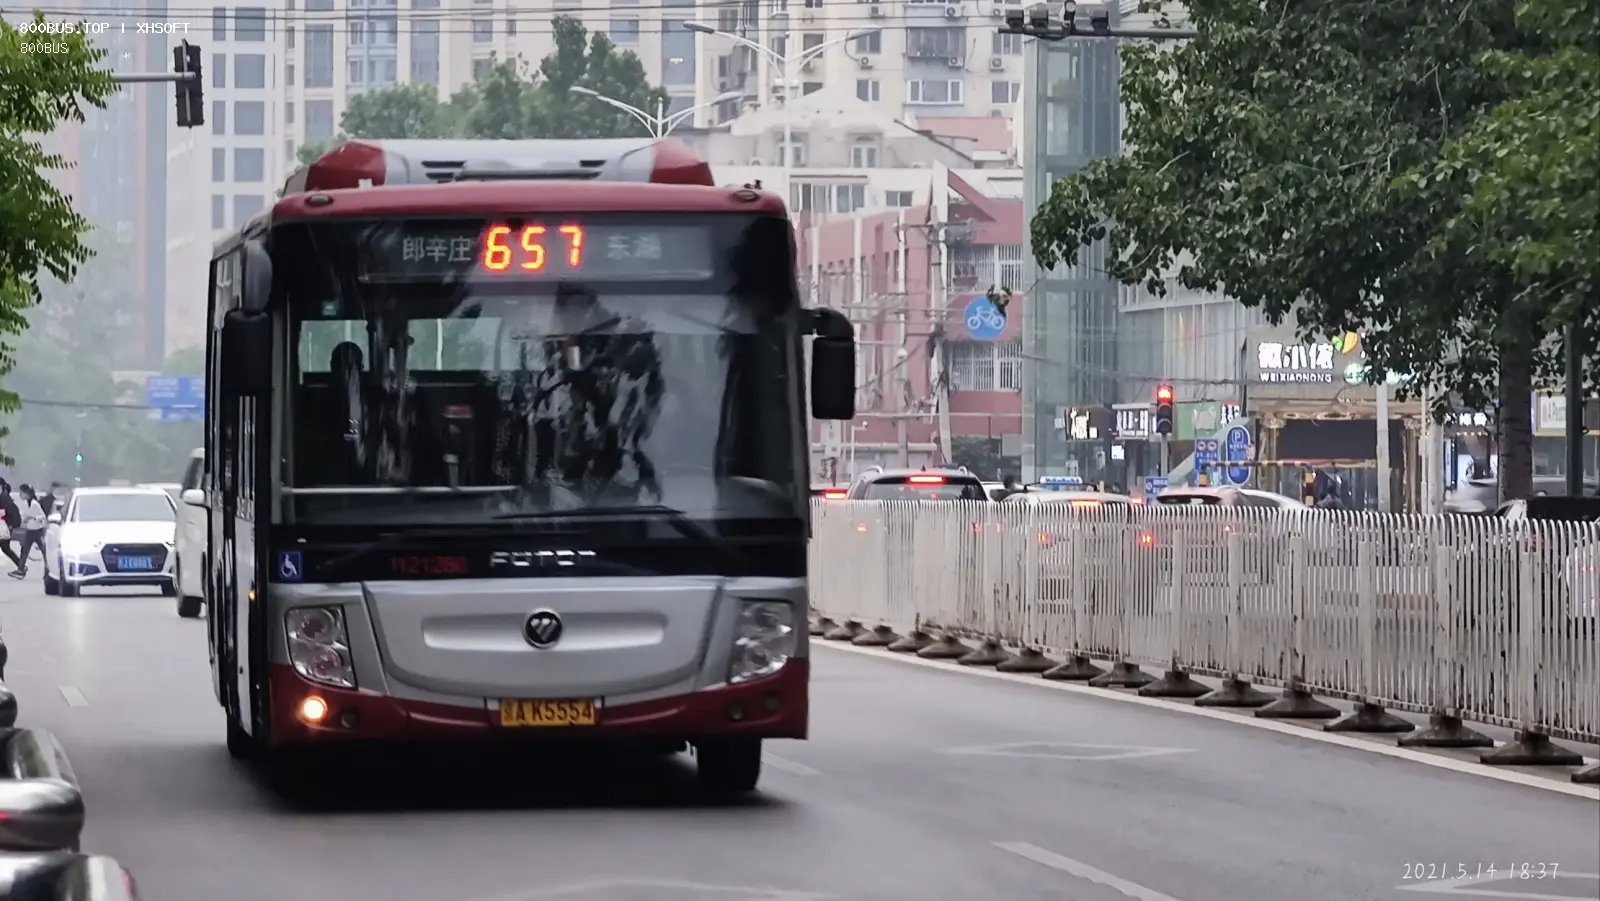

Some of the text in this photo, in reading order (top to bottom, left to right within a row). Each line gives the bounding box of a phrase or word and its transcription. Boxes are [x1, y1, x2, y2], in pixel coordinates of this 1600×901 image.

[402, 235, 472, 262] 郎辛庄
[485, 224, 584, 271] 657
[532, 698, 592, 721] K5554
